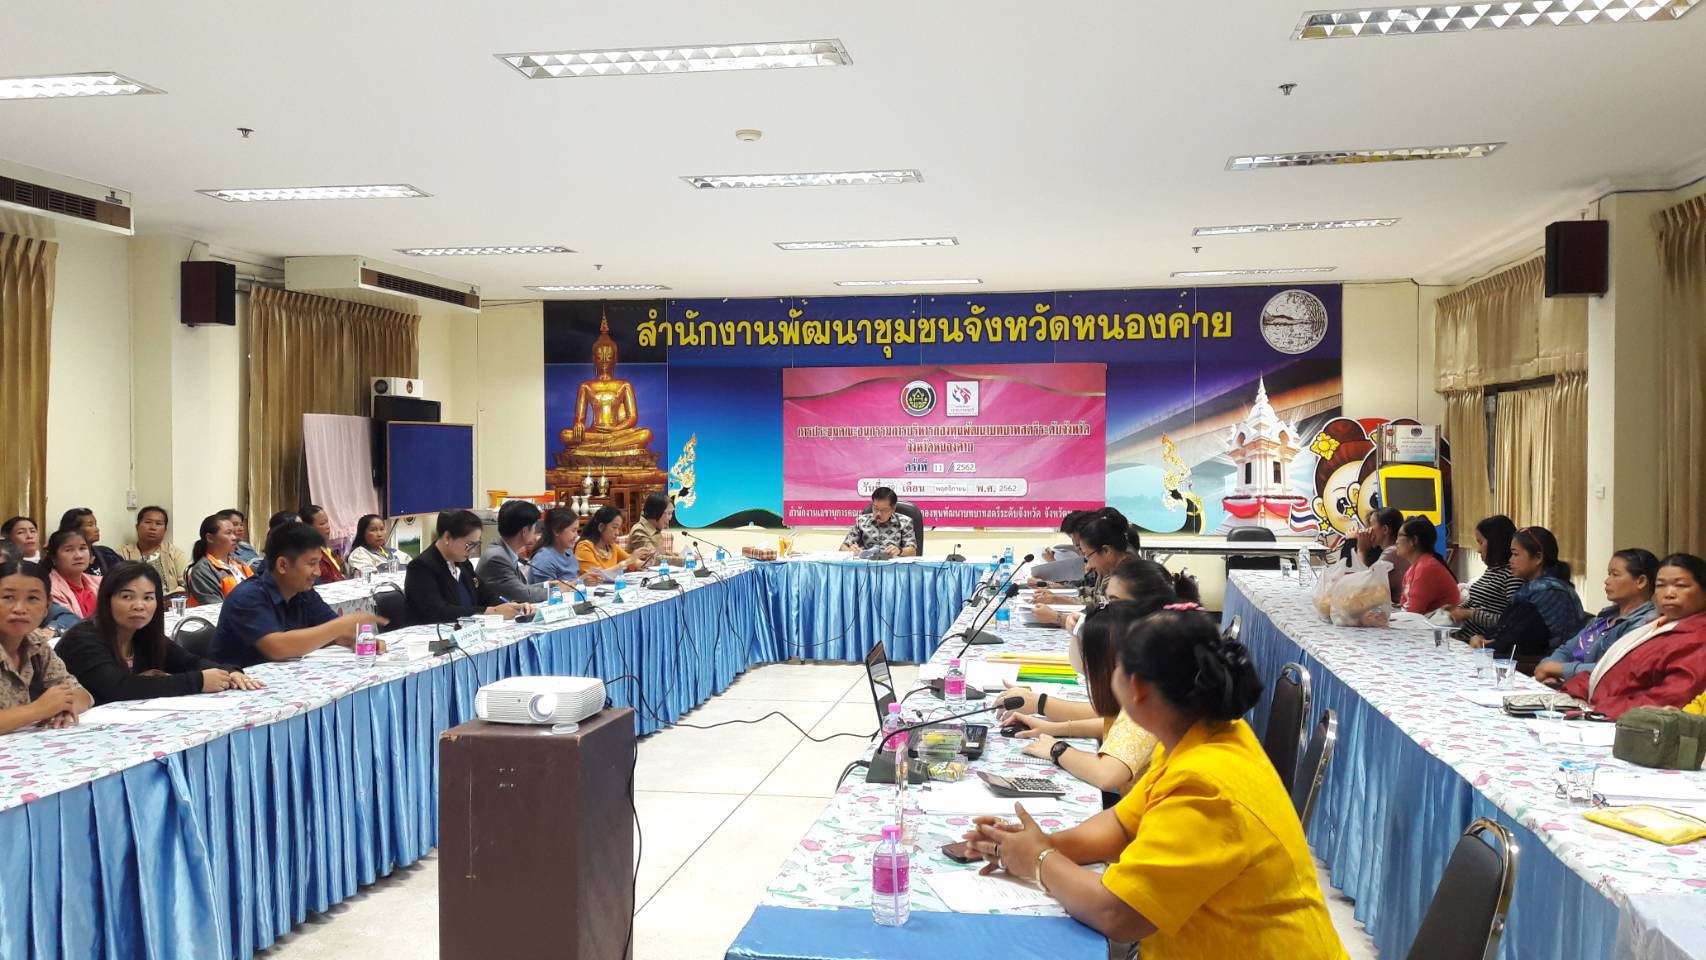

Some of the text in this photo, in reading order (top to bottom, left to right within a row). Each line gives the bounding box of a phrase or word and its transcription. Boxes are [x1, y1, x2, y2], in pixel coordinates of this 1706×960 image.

[636, 303, 1232, 359] สำนักงานพัฒนาชุมชนจังหวัดหนองคาย
